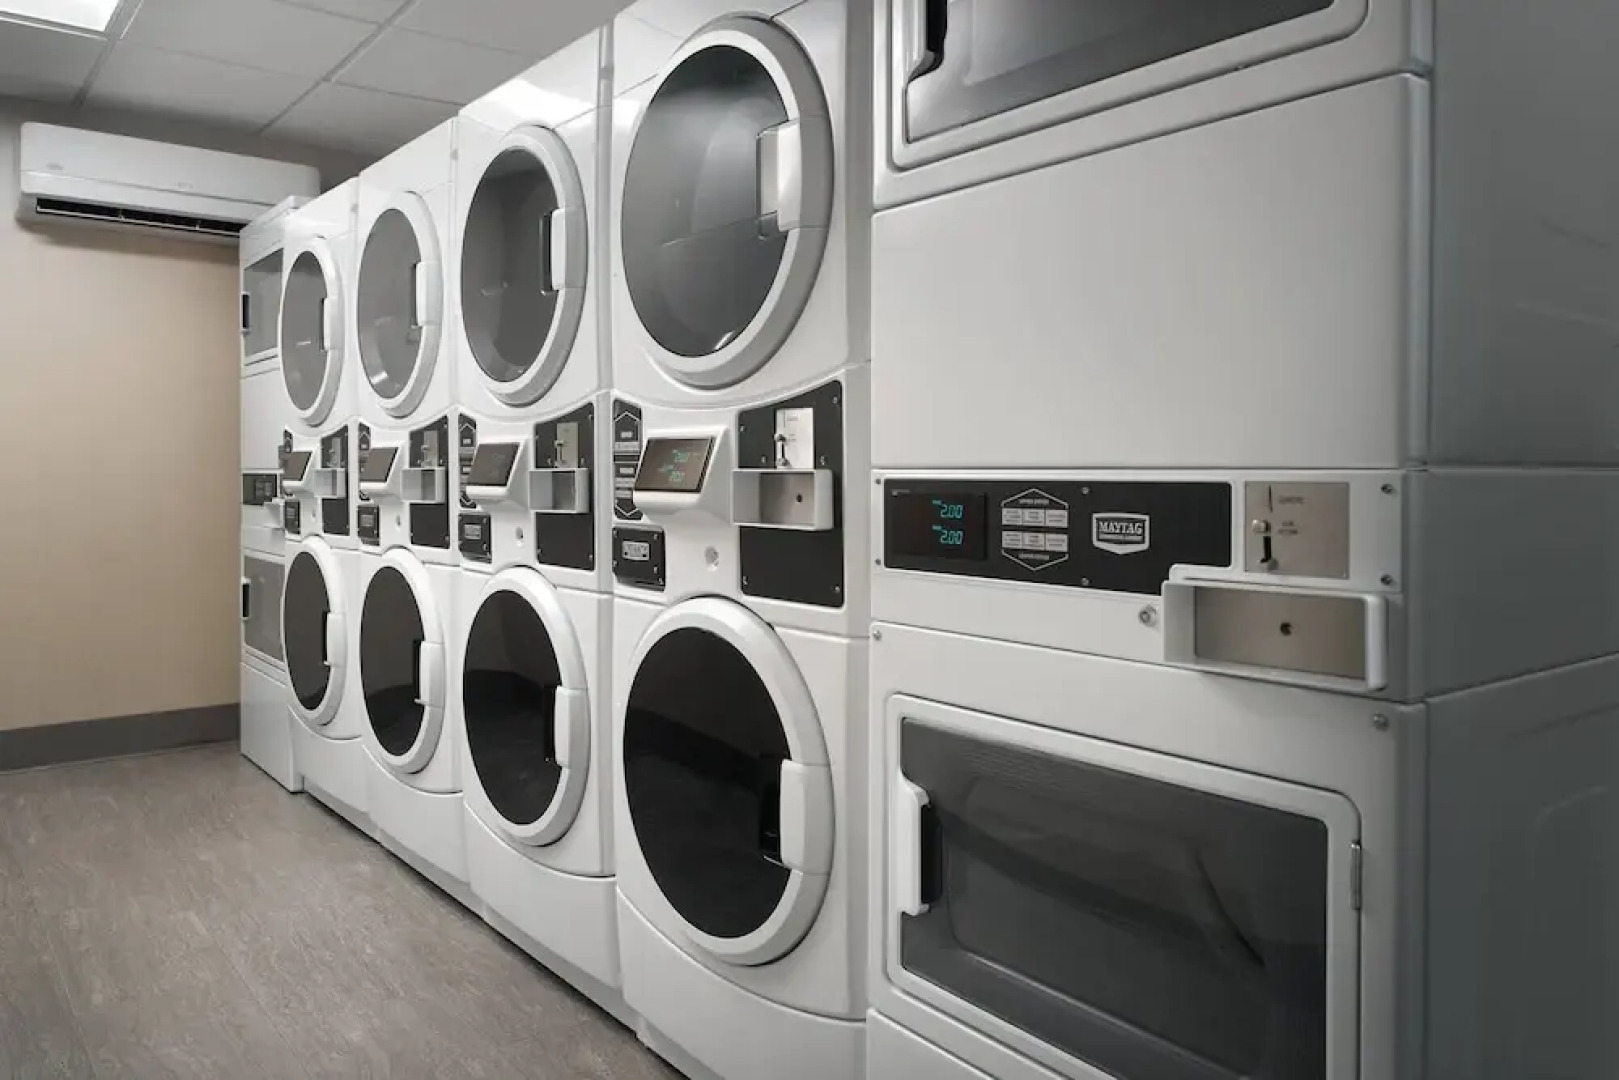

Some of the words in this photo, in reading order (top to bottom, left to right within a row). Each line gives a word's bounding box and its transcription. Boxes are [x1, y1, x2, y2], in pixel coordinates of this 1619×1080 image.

[940, 504, 963, 518] 2.00
[1098, 520, 1143, 535] MAYTAG
[940, 530, 963, 545] 2.00
